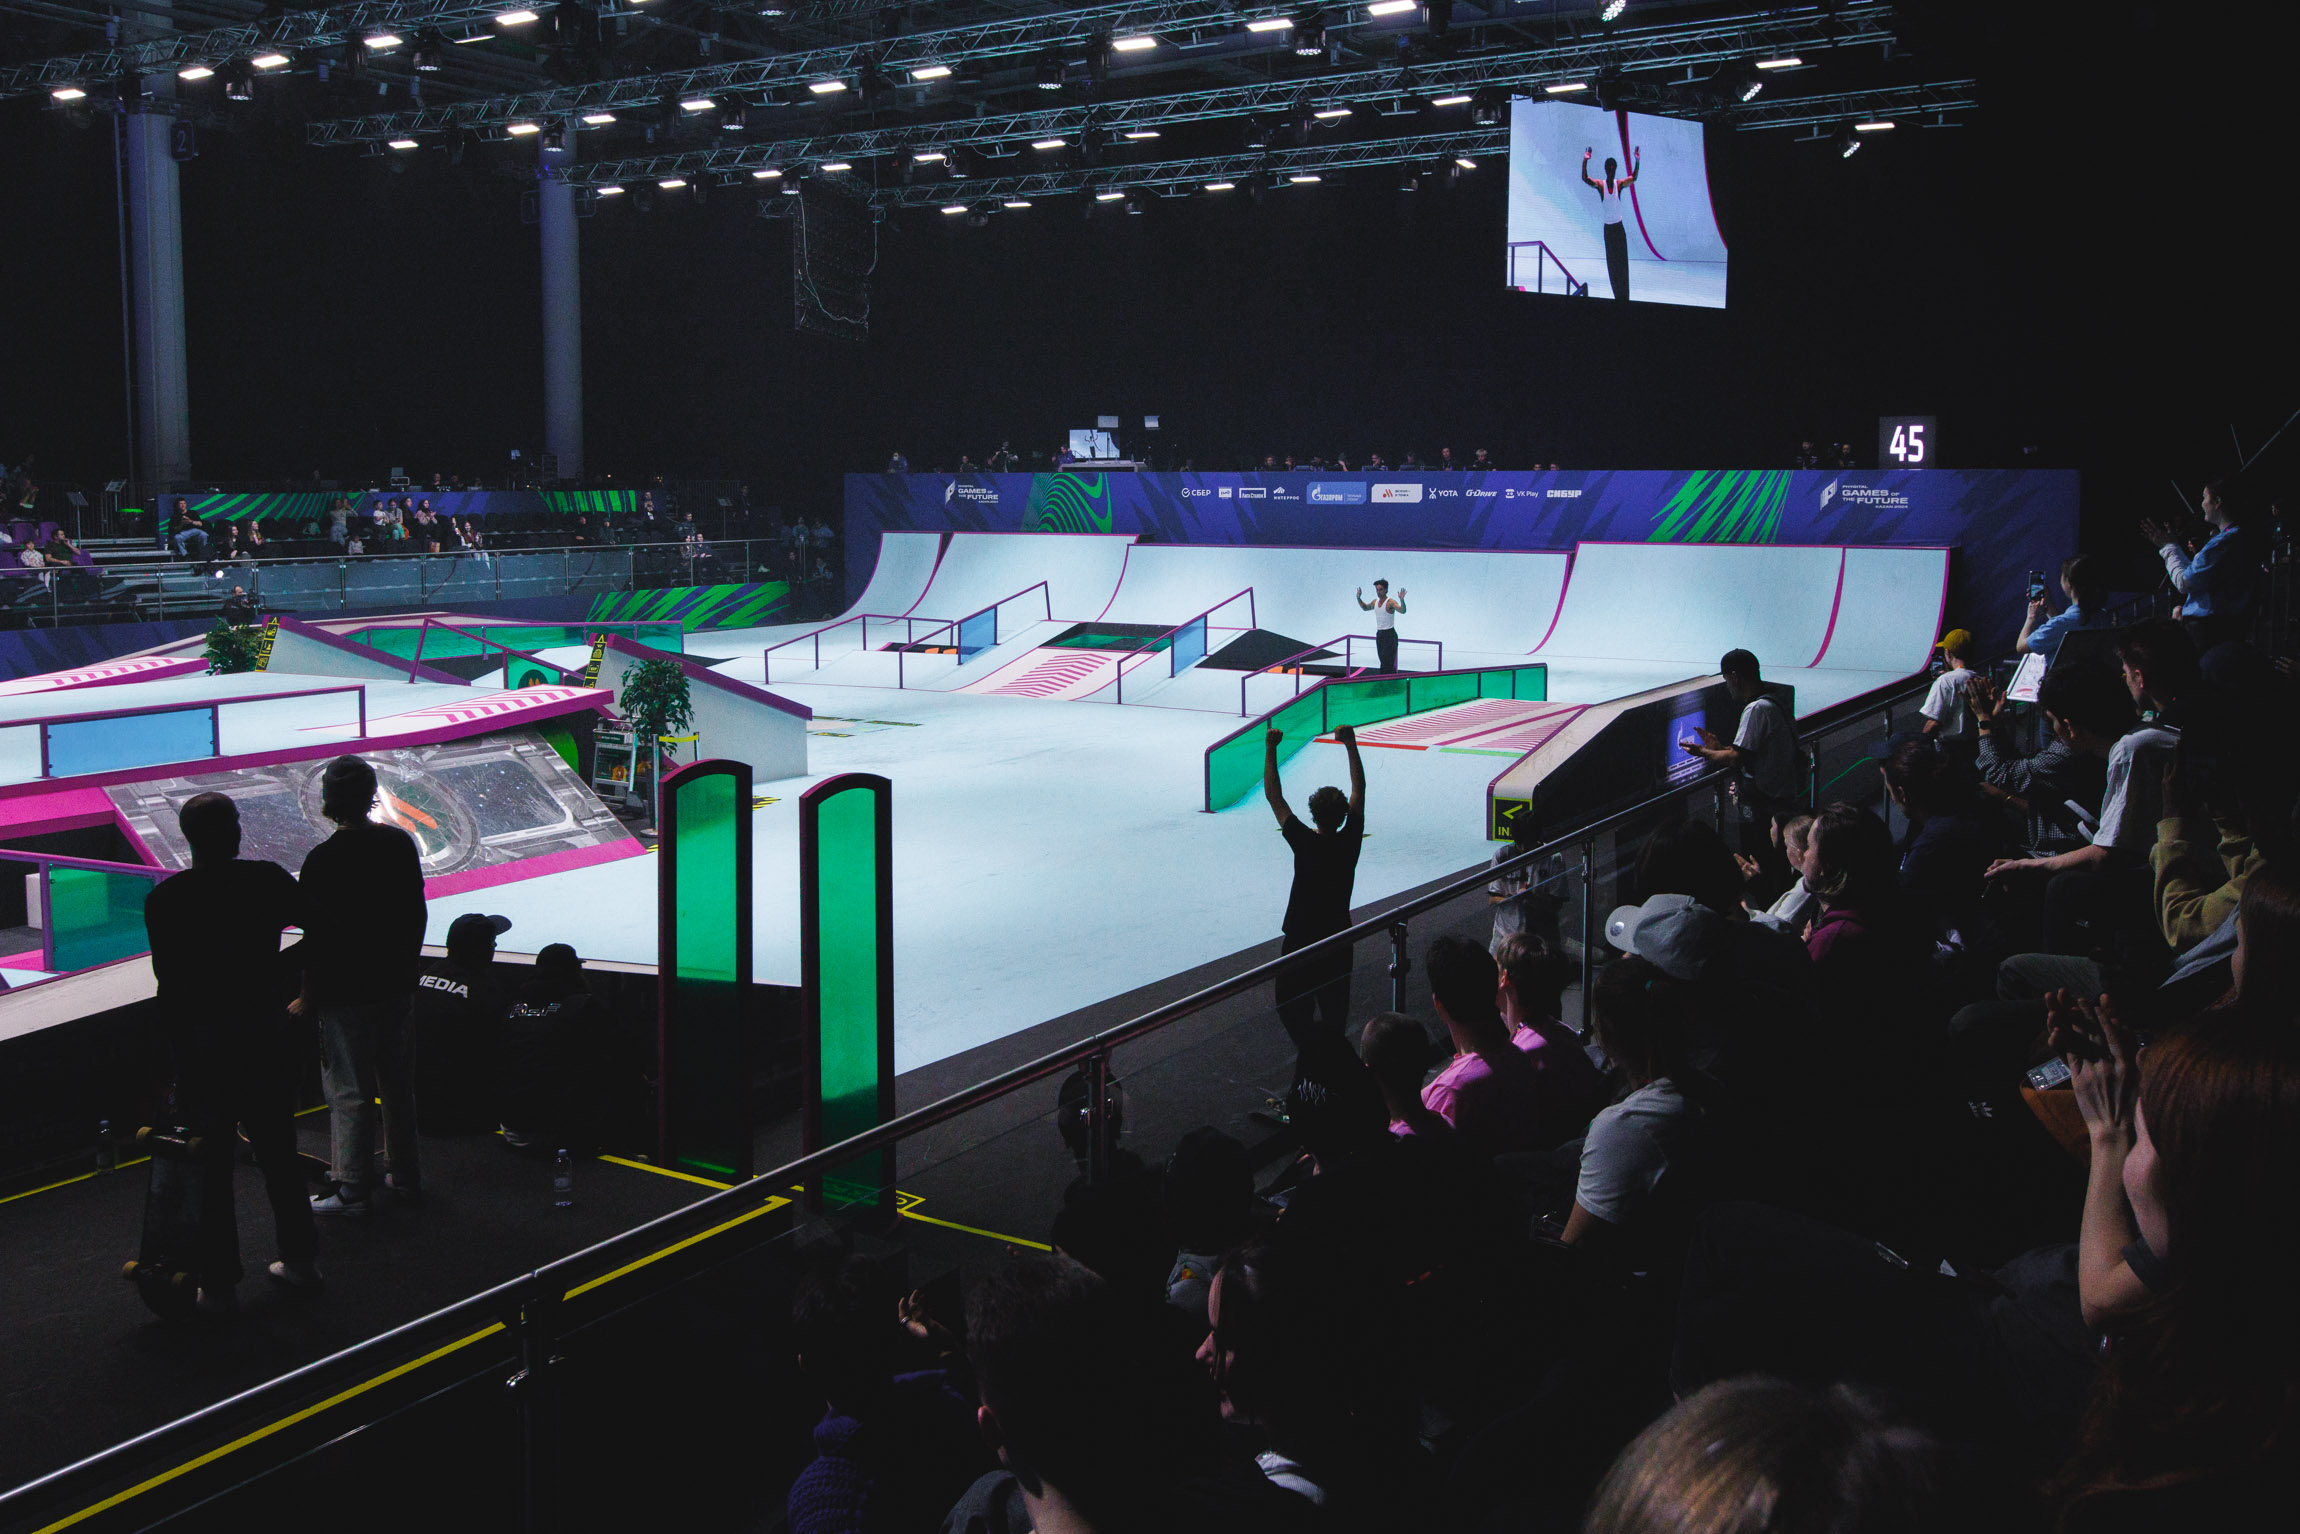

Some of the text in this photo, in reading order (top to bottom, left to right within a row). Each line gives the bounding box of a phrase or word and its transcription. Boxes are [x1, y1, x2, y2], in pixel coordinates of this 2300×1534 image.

[177, 129, 186, 152] 2
[1889, 425, 1924, 462] 45
[1526, 490, 1539, 498] Play
